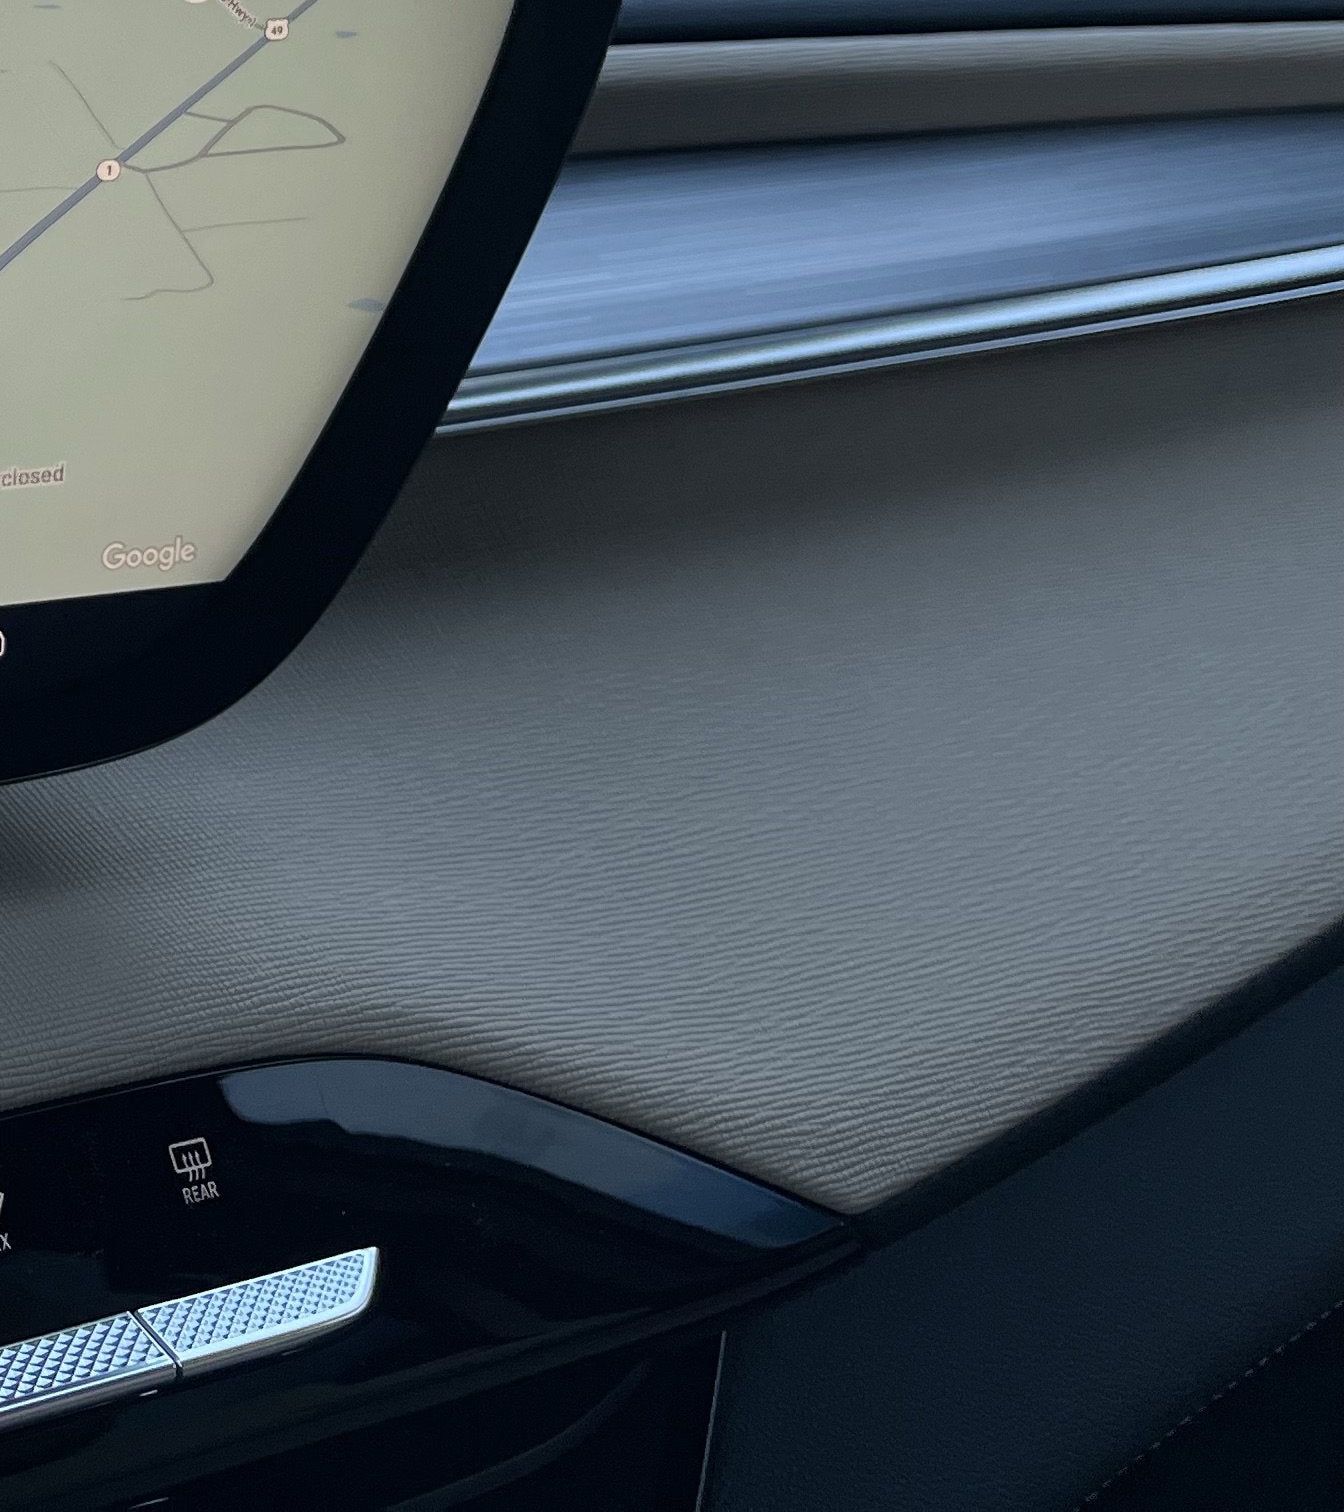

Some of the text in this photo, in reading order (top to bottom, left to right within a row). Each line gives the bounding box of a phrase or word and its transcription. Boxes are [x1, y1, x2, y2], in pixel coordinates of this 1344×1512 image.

[271, 25, 283, 35] 49
[1, 464, 65, 487] closed
[102, 536, 196, 571] Google
[182, 1180, 220, 1205] REAR
